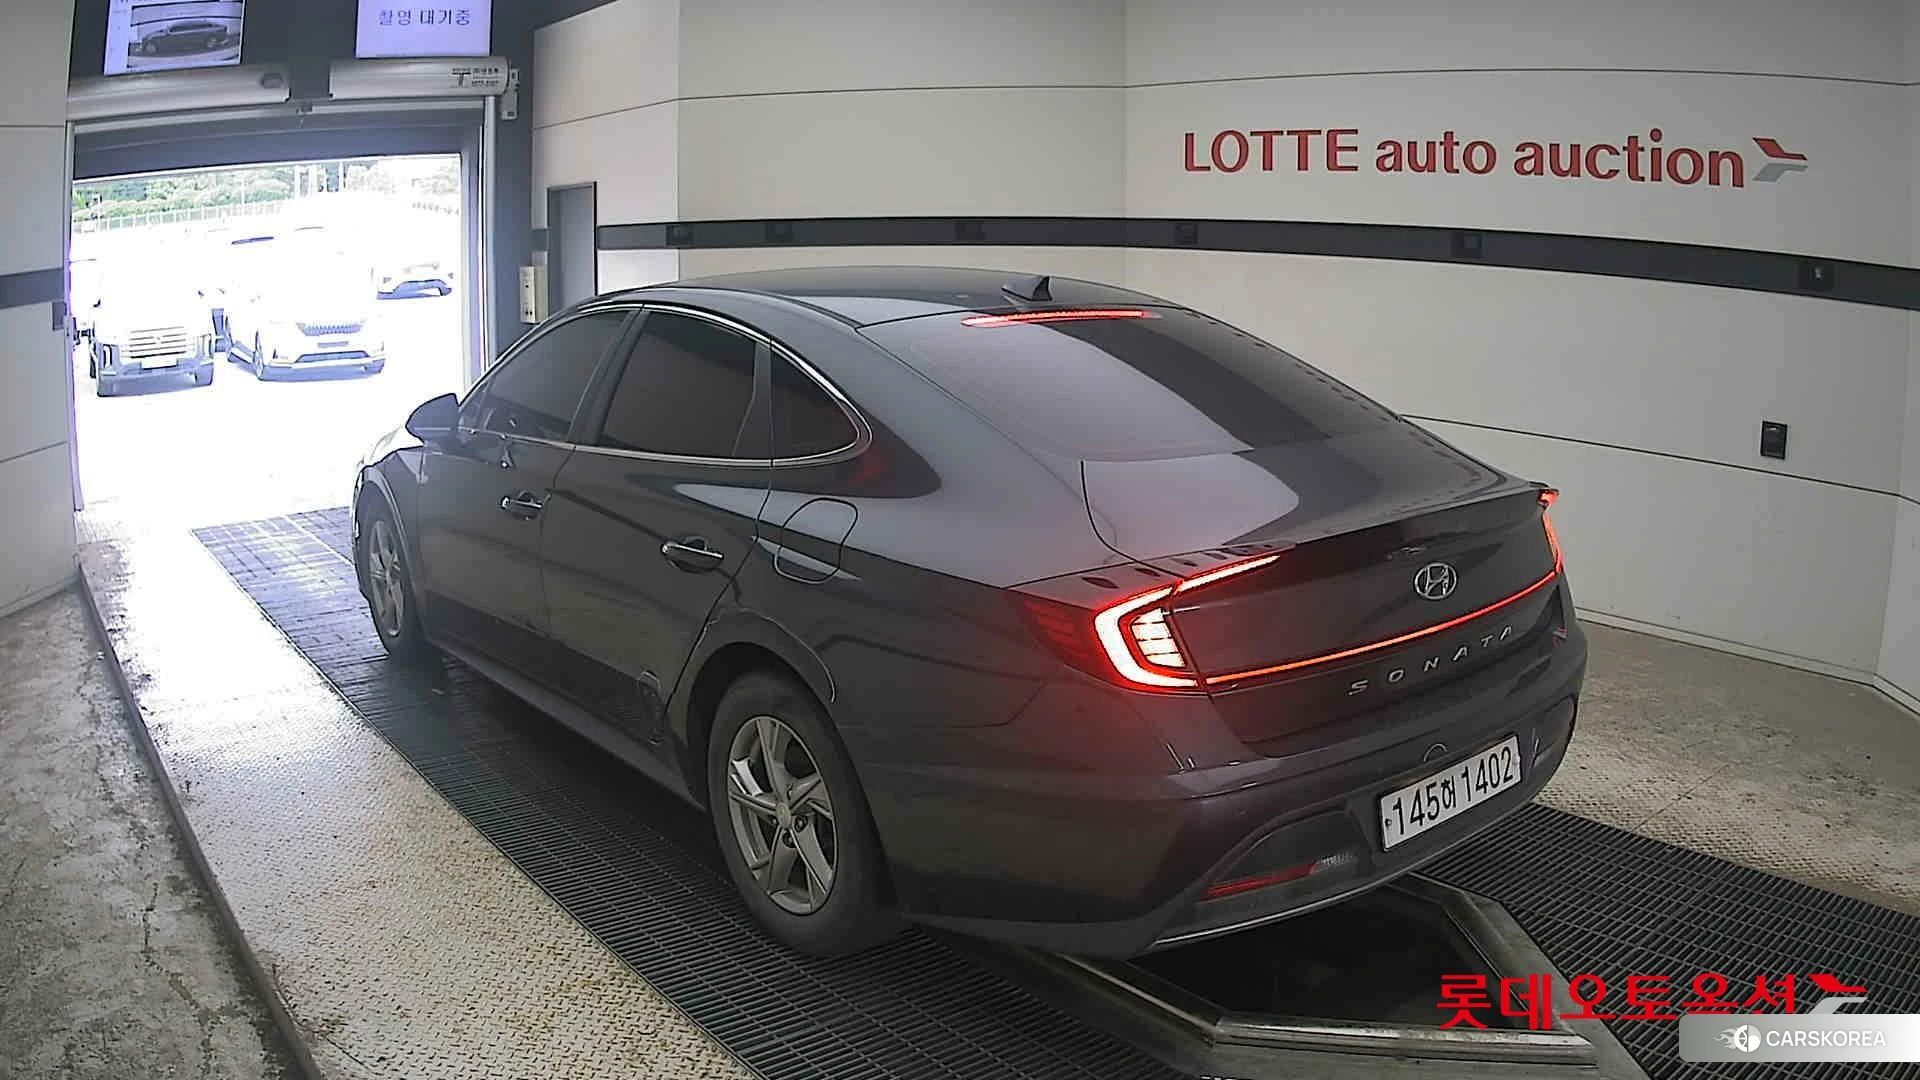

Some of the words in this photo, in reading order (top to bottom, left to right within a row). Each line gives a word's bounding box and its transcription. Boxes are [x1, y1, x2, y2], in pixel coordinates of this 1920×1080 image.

[420, 8, 471, 26] 대기중
[1184, 129, 1358, 172] LOTTE
[1375, 131, 1497, 175] auto
[1513, 128, 1744, 188] auction
[1347, 624, 1514, 697] SONATA
